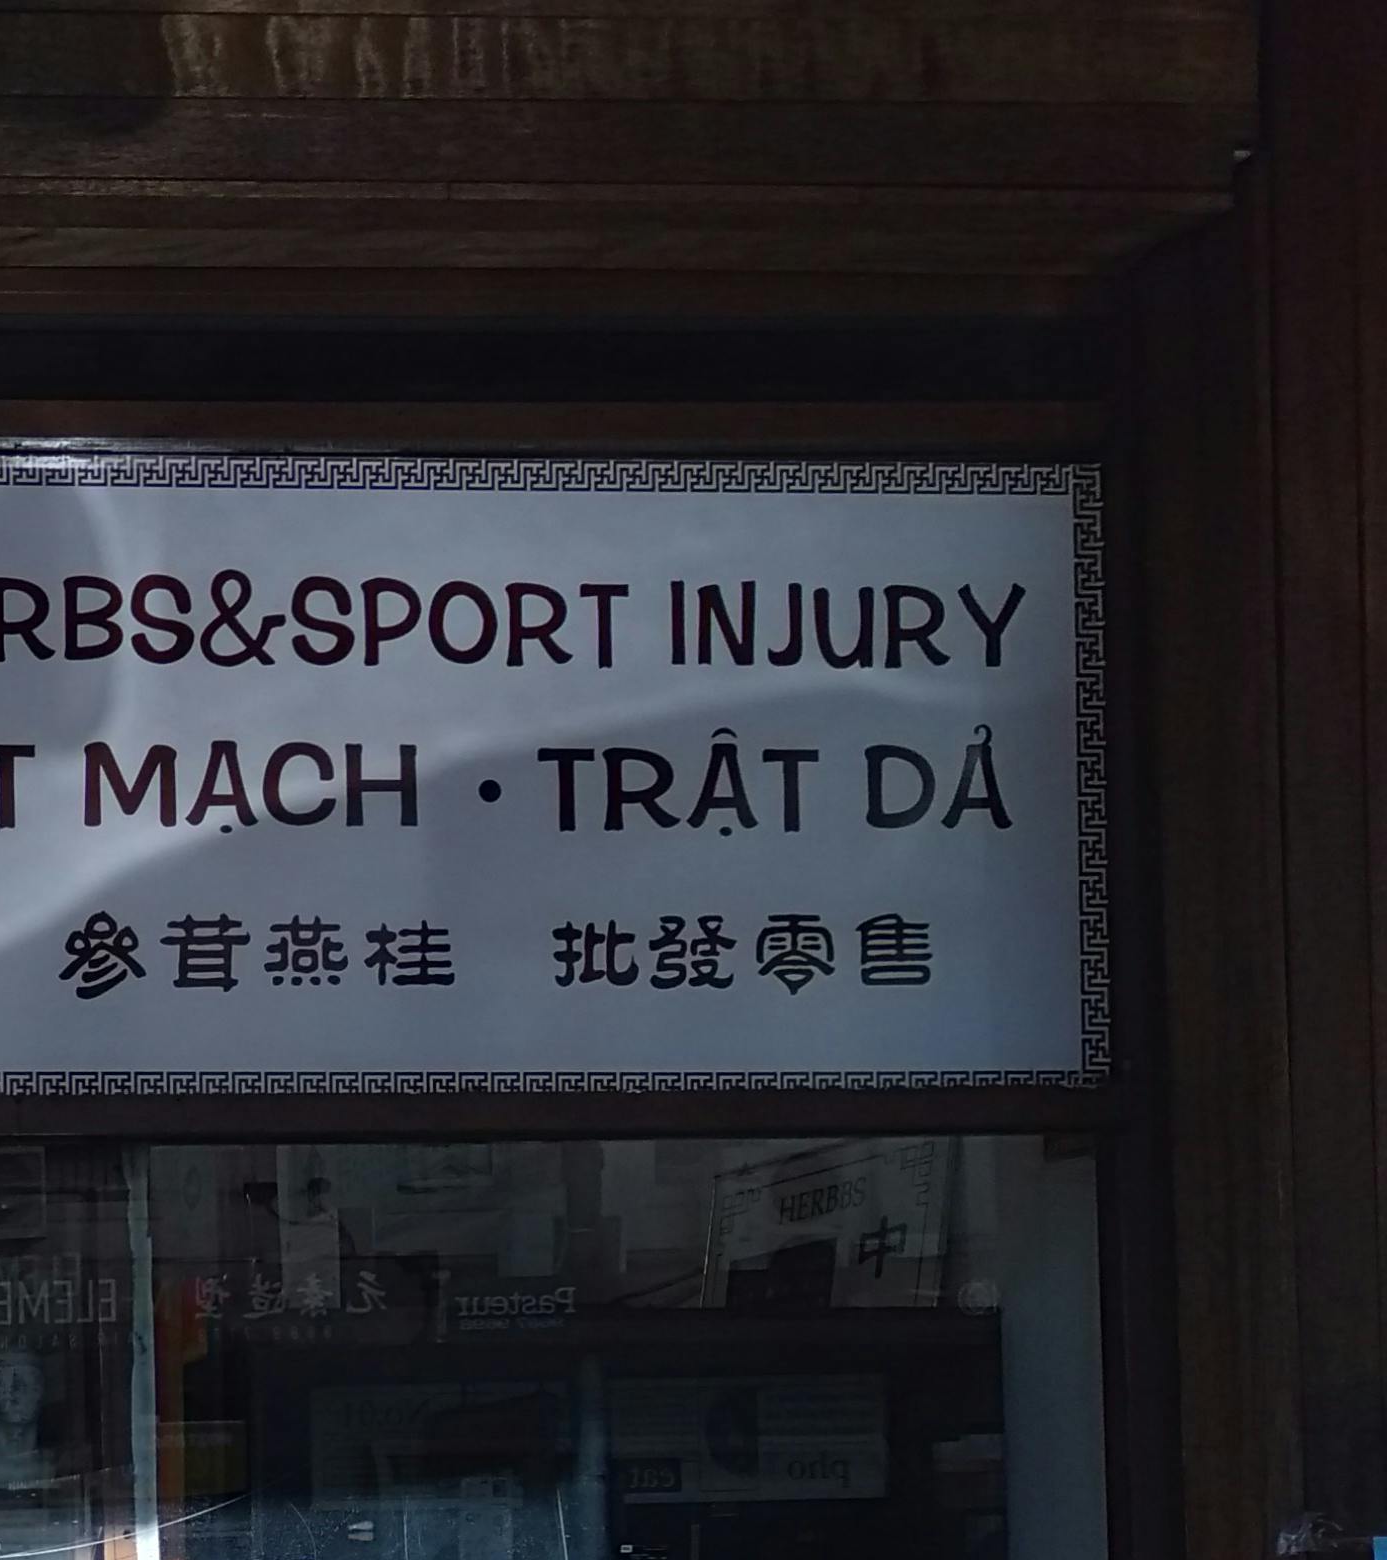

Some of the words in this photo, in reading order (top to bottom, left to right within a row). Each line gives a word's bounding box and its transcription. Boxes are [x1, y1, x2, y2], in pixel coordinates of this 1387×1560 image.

[670, 578, 1027, 670] INJURY
[83, 741, 419, 835] MẠCH
[538, 727, 821, 839] TRẬT
[865, 723, 1014, 831] DẢ
[58, 911, 456, 999] 參茸燕桂
[551, 912, 935, 996] 批發零售
